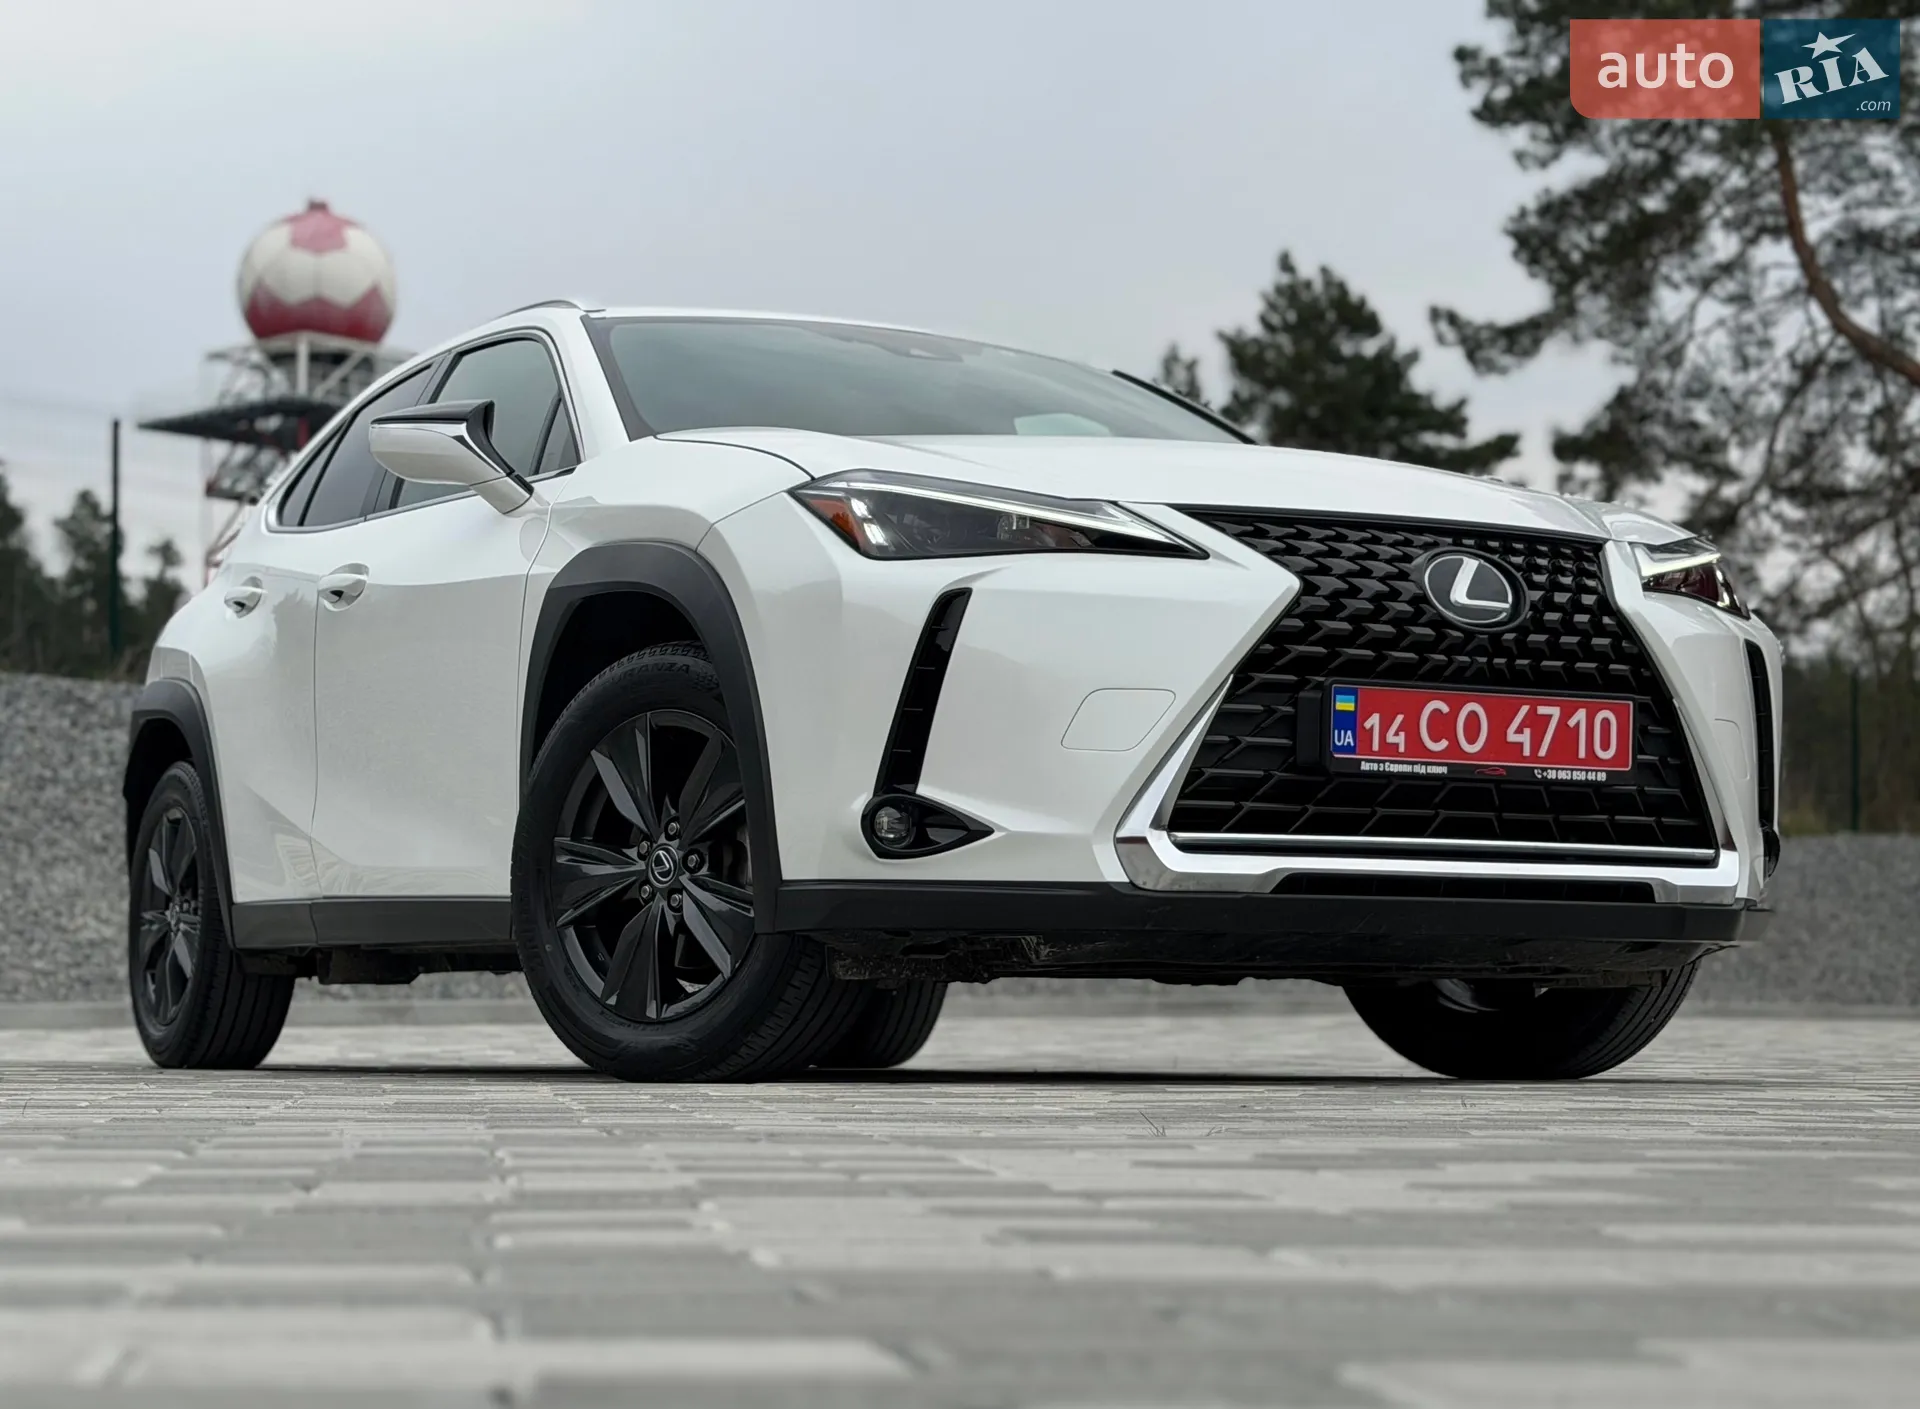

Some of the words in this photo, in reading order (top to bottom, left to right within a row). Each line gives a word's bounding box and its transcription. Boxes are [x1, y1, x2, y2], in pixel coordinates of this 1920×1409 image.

[1334, 729, 1355, 747] UA
[1362, 712, 1406, 753] 14
[1418, 699, 1488, 754] CO
[1505, 704, 1618, 761] 4710
[1360, 761, 1378, 771] Авто
[1413, 763, 1426, 774] під
